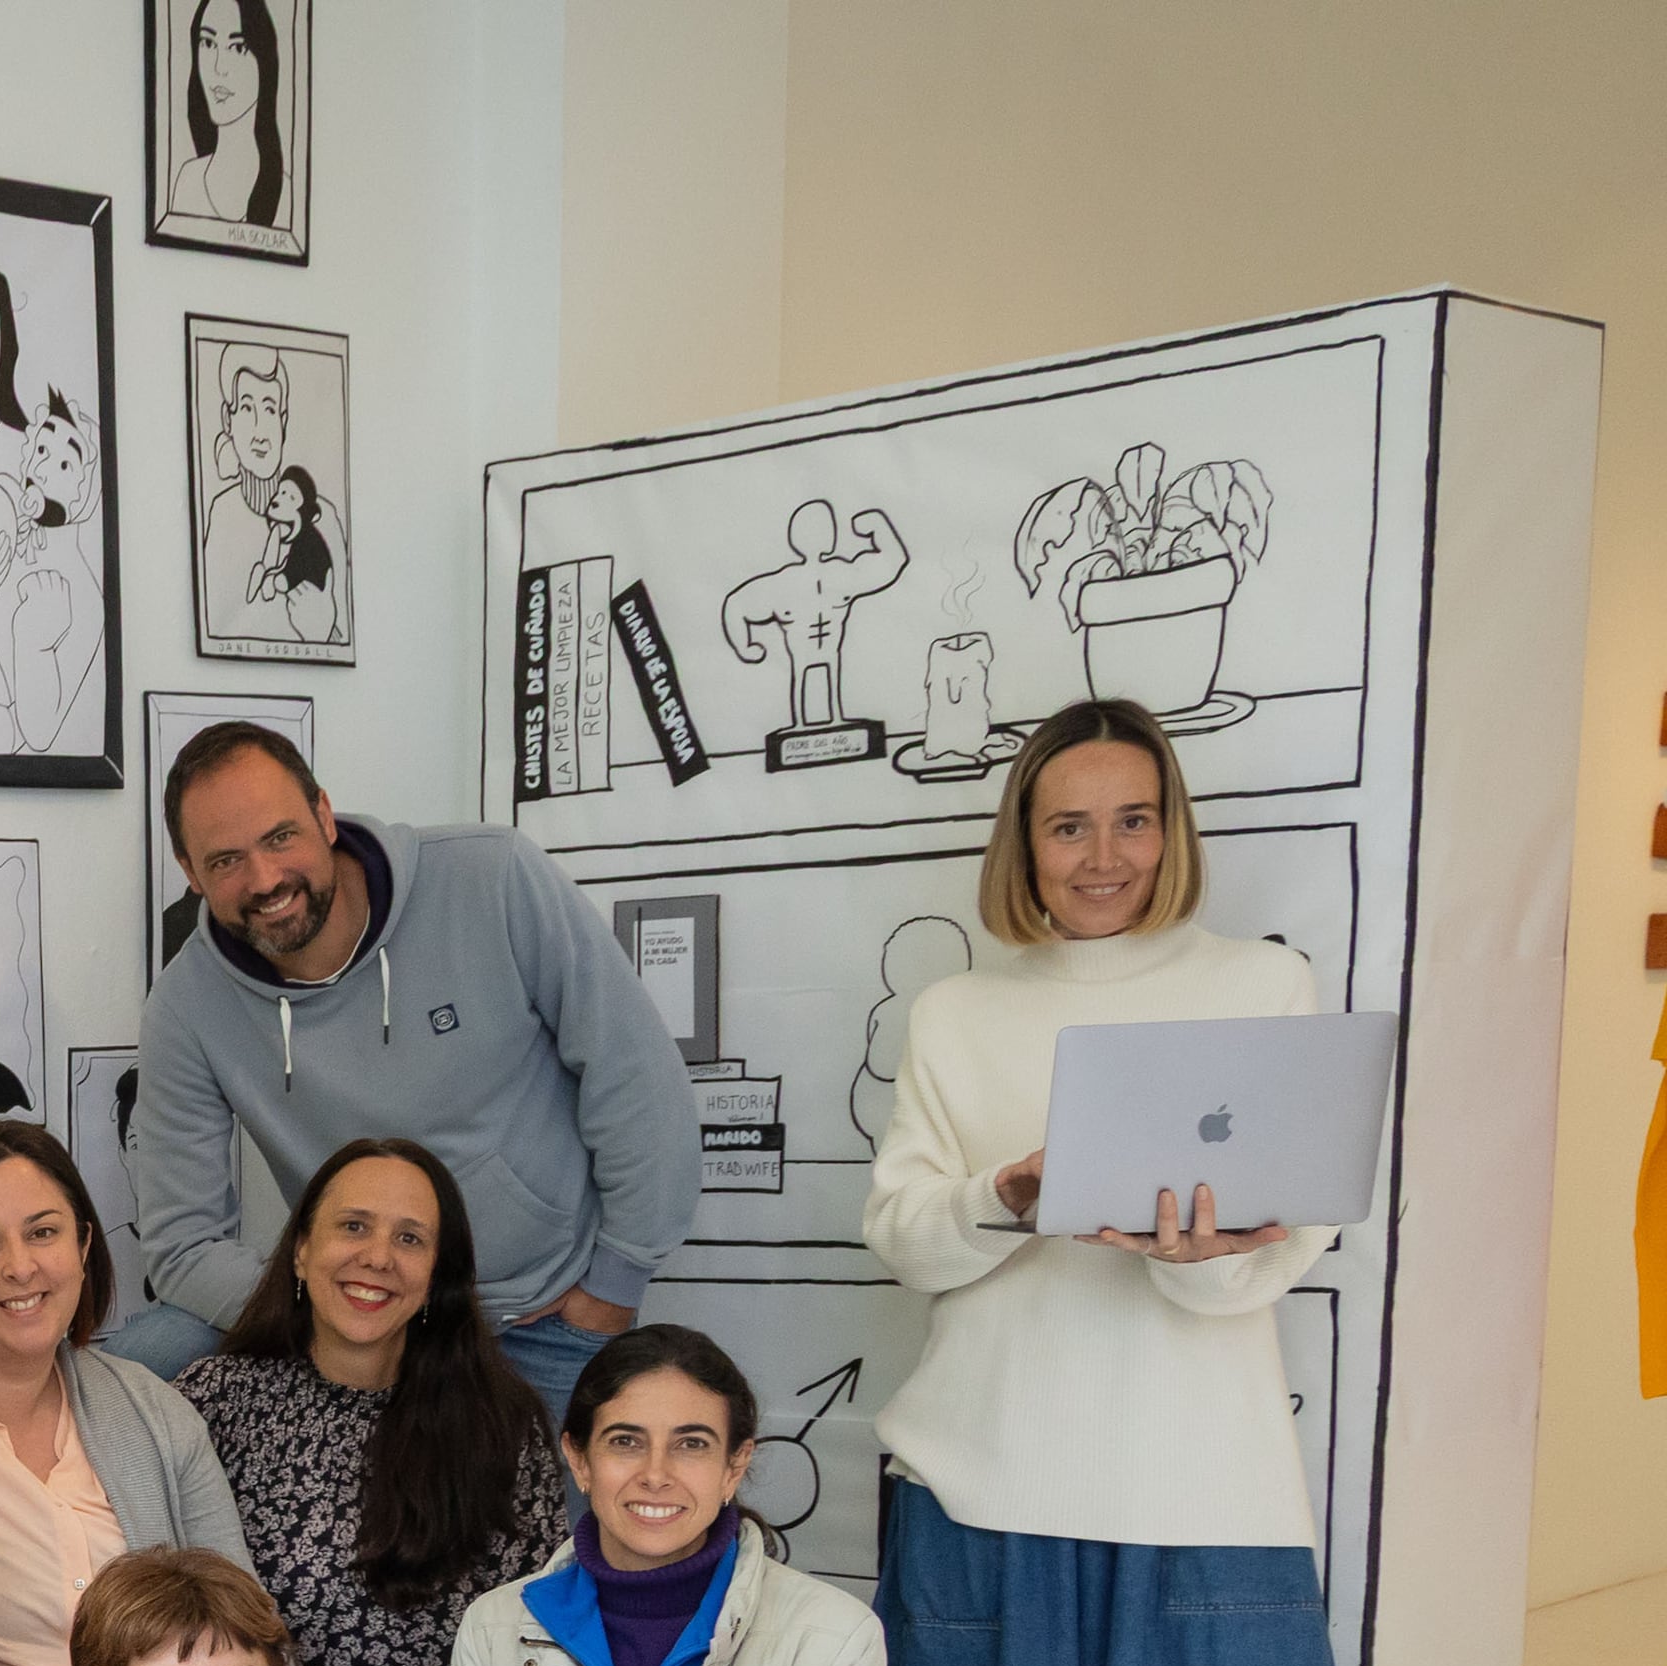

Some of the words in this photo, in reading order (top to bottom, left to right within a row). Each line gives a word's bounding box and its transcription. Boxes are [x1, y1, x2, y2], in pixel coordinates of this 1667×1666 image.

[524, 578, 545, 662] CUÑADO
[556, 582, 572, 672] LIMPIEZA
[619, 599, 657, 658] DIARIO
[218, 643, 251, 653] JANE
[645, 656, 668, 681] DE
[526, 667, 544, 696] DE
[581, 611, 605, 737] RECETAS
[652, 678, 671, 702] LA
[554, 681, 570, 752] MEJOR
[658, 697, 695, 766] ESPOSA
[524, 705, 545, 789] CHISTES
[555, 761, 572, 786] LA
[707, 1095, 775, 1111] HISTORIA
[704, 1130, 762, 1147] MARIDO
